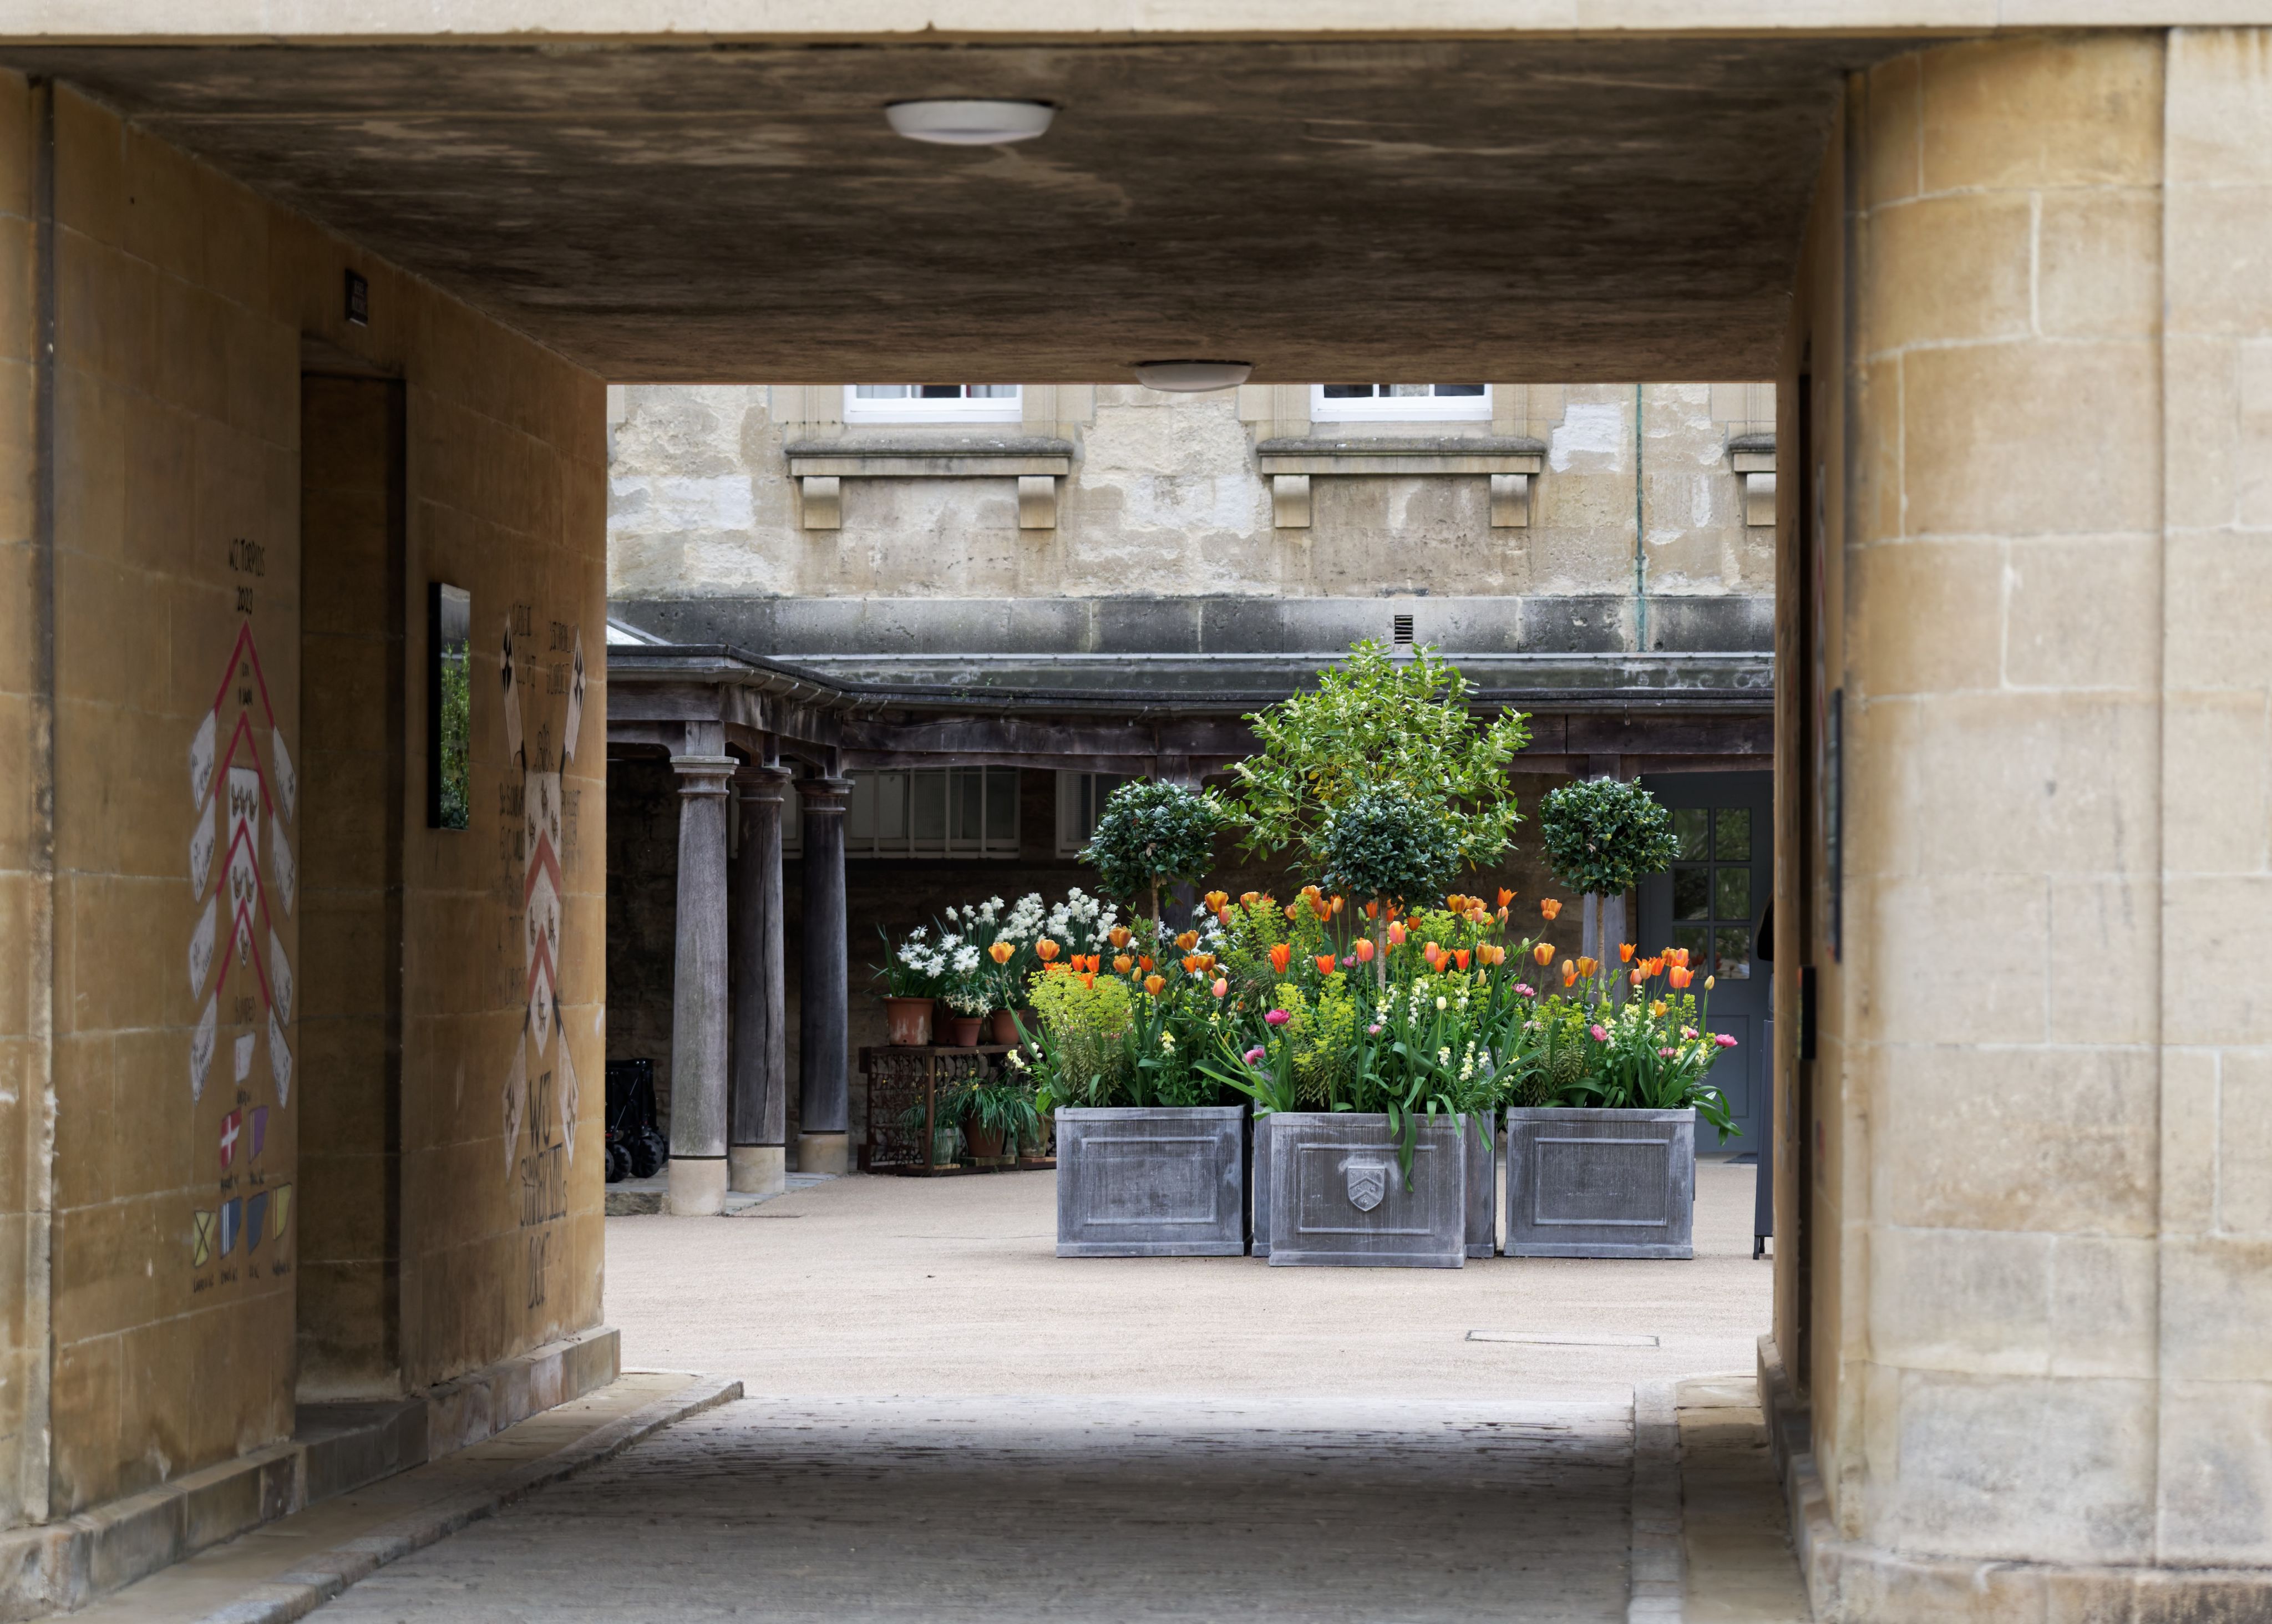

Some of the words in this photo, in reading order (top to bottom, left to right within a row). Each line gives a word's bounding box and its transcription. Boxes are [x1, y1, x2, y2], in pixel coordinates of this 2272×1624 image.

[229, 539, 239, 571] W2
[241, 539, 266, 577] TORPIDS
[237, 585, 253, 615] 2023
[529, 1069, 551, 1151] W3
[520, 1150, 547, 1227] SUMMER
